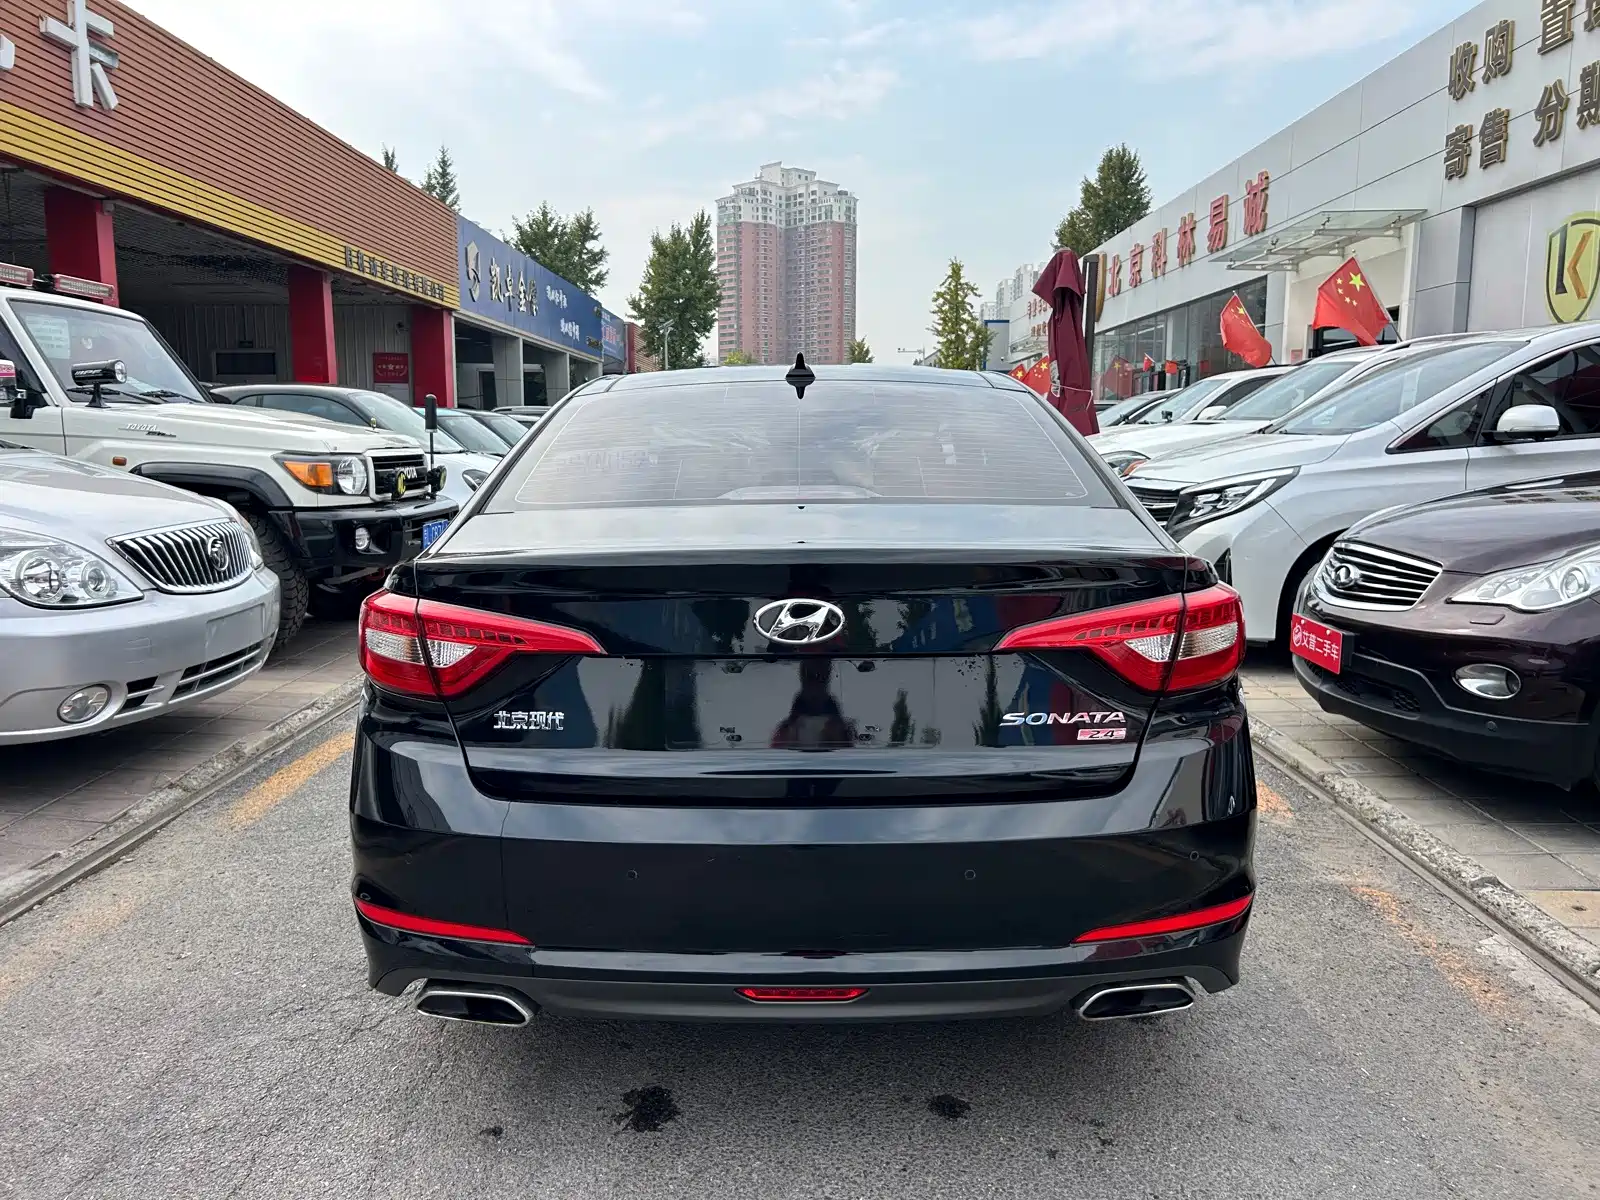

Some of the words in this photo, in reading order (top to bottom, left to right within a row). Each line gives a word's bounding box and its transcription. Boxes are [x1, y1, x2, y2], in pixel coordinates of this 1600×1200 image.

[0, 0, 119, 110] 卡
[1448, 20, 1516, 101] 收购
[1444, 108, 1510, 180] 寄售
[1107, 170, 1270, 297] 北京科林易诚
[126, 423, 158, 432] TOYOTA
[494, 711, 564, 730] 北京现代
[1000, 711, 1126, 726] SONATA
[1088, 729, 1115, 739] 2.4
